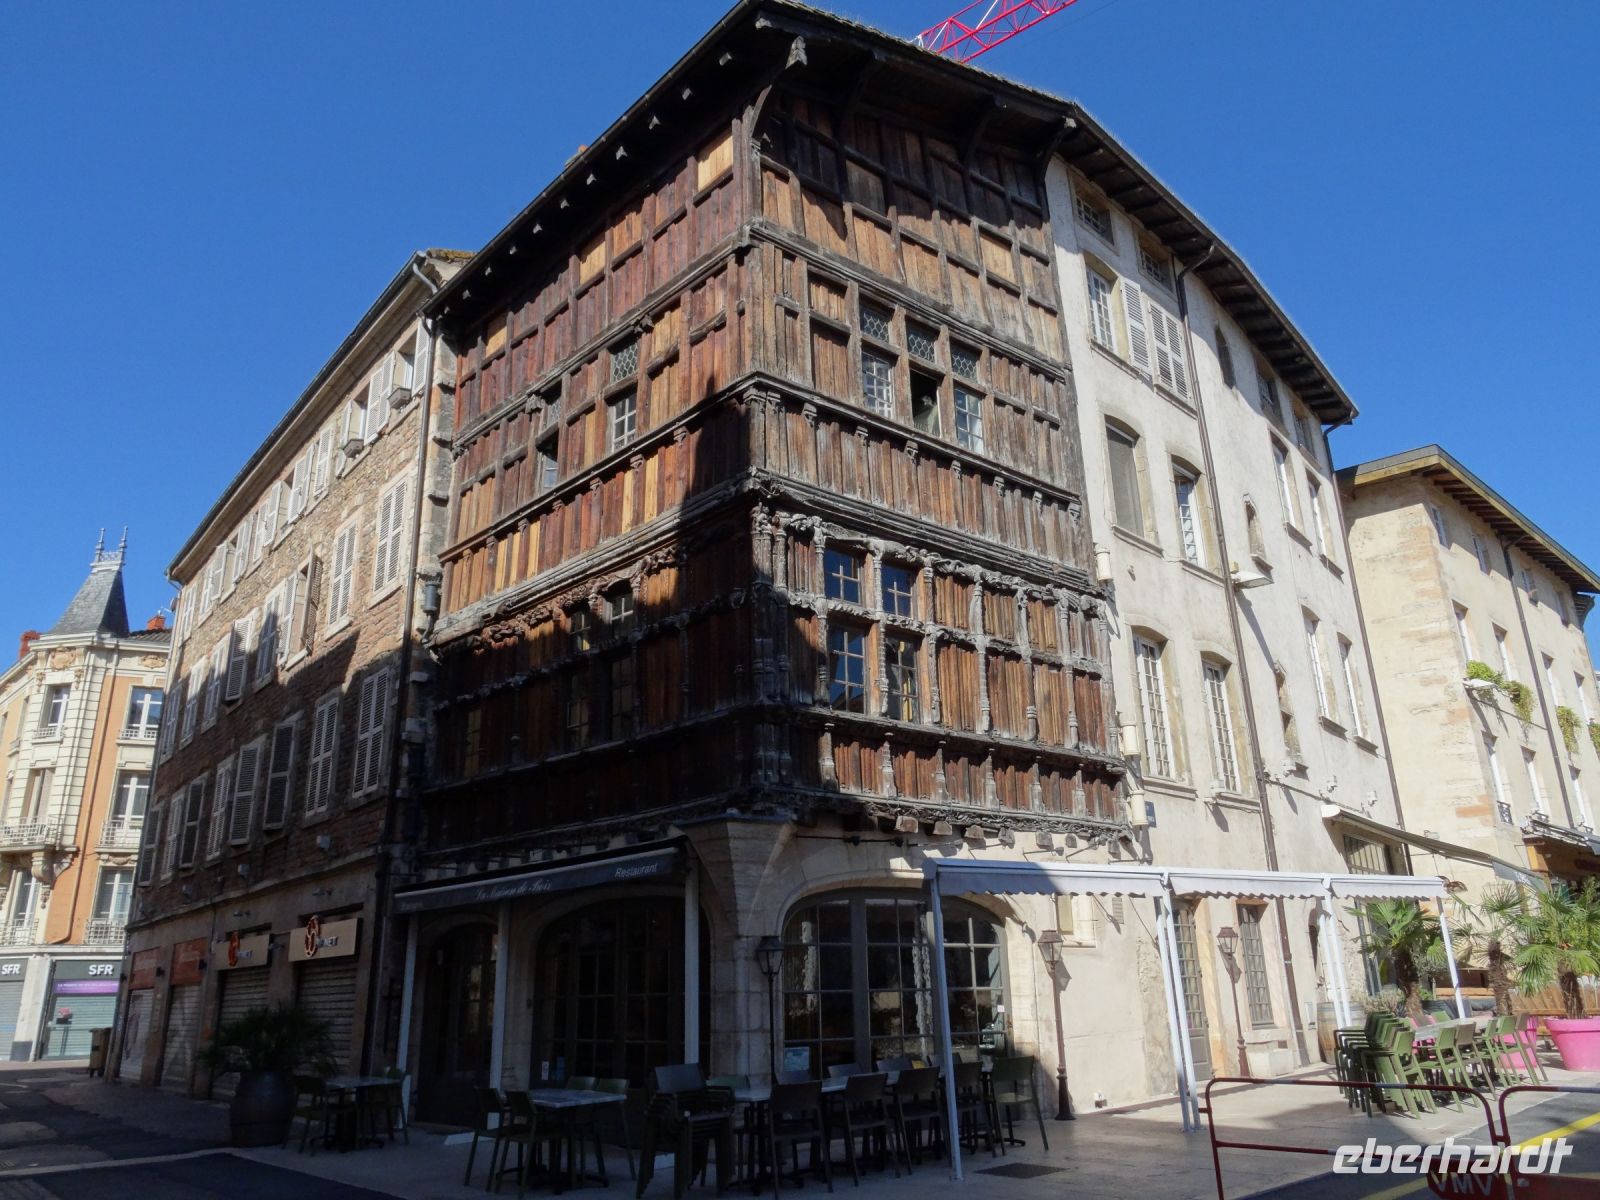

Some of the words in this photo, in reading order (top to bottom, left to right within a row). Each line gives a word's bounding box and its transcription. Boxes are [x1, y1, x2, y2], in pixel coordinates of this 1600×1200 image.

[614, 863, 658, 879] Restaurant
[1, 963, 21, 975] SFR
[88, 964, 114, 976] SFR
